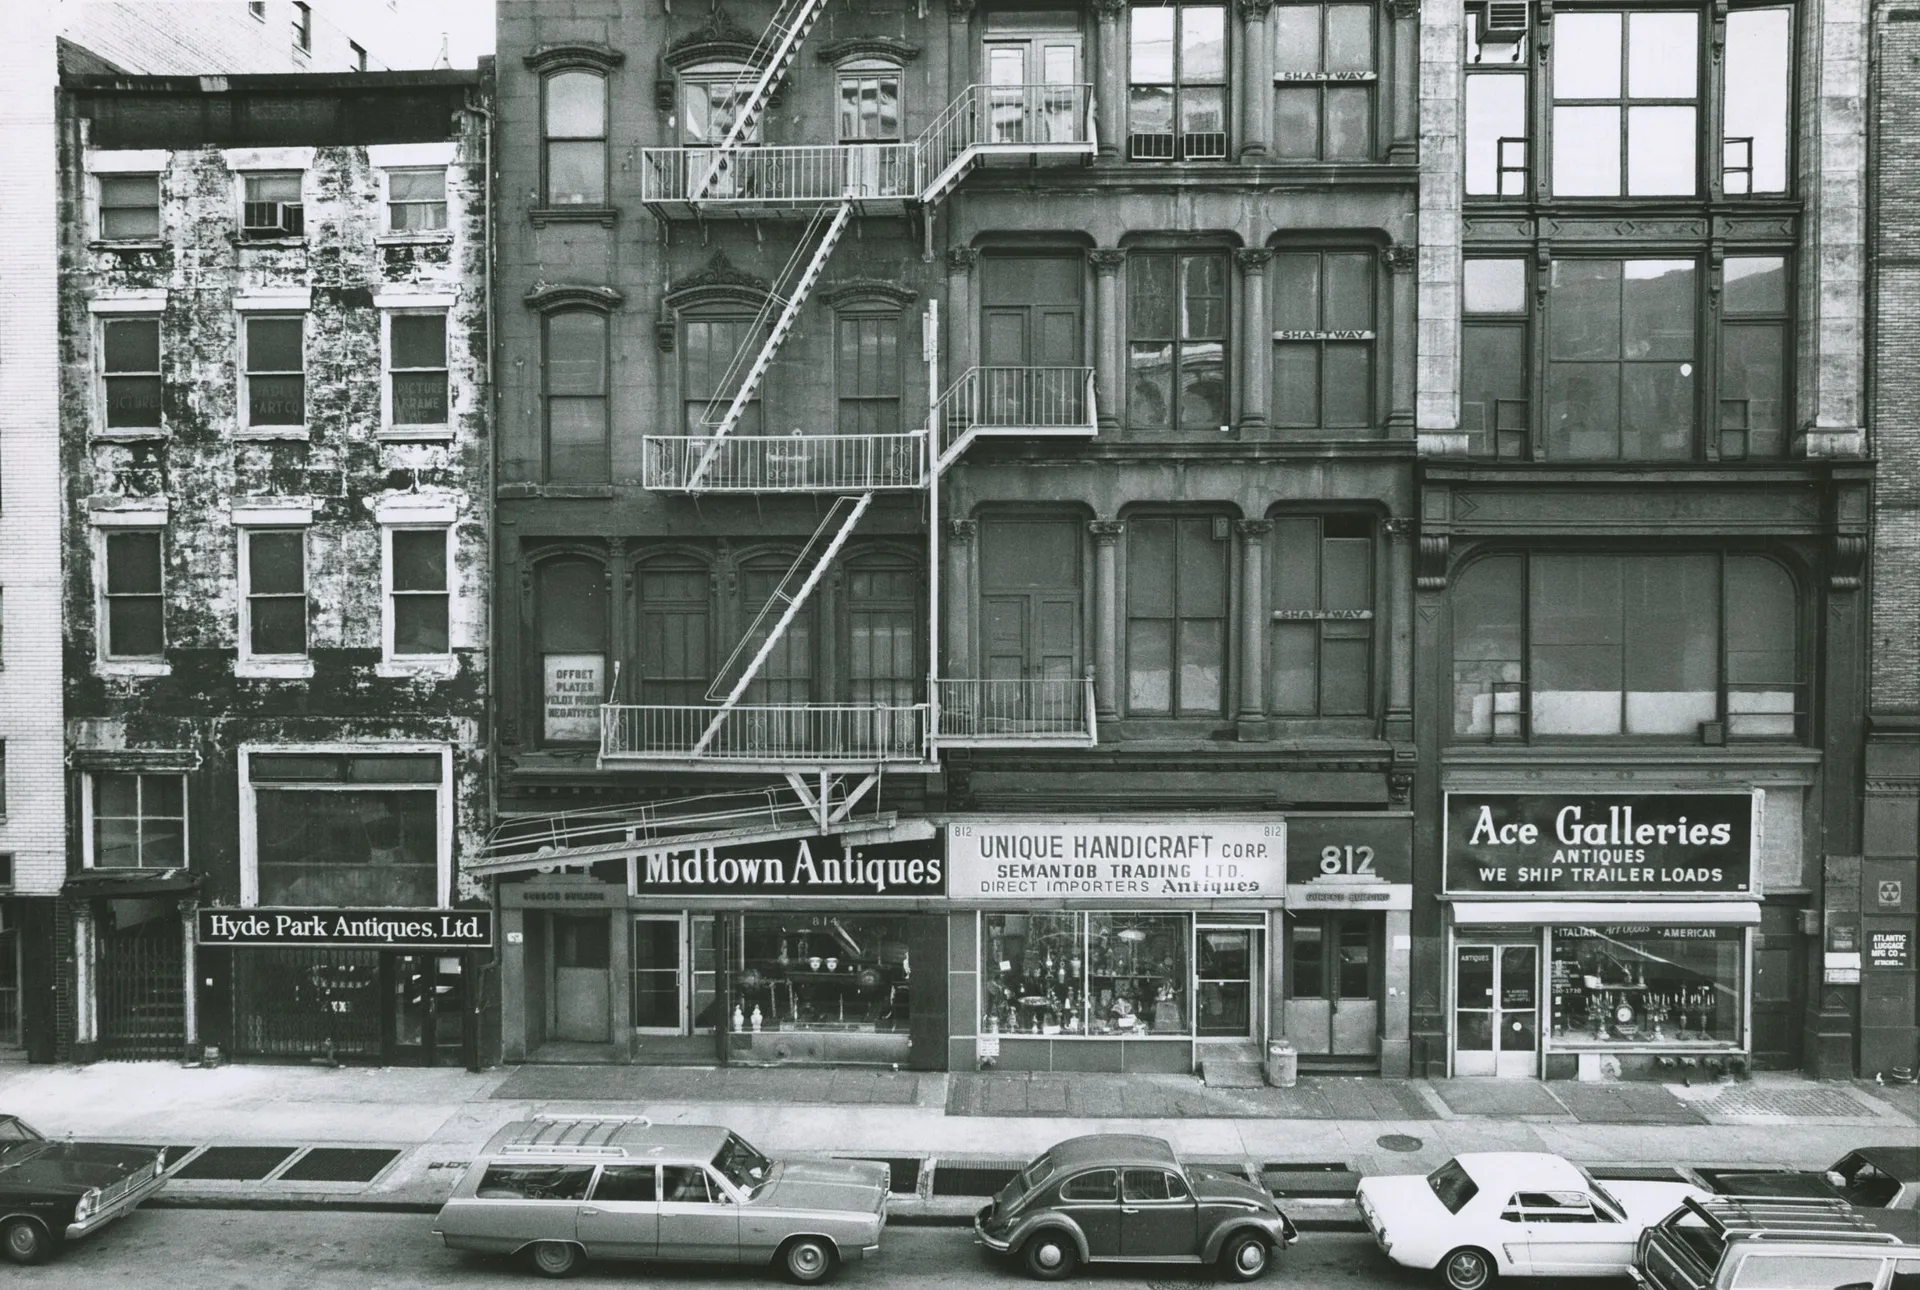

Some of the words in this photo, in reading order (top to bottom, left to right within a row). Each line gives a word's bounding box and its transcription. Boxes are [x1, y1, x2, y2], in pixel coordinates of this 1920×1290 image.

[1284, 72, 1366, 80] SHAFTWAY
[1282, 330, 1366, 339] SHAFTWAY
[556, 669, 594, 679] OFFSET
[556, 682, 594, 692] PLATES
[1469, 805, 1539, 845] Ace
[1556, 805, 1732, 846] Galleries
[956, 827, 971, 837] 812
[1264, 827, 1281, 837] 812
[981, 836, 1063, 860] UNIQUE
[1075, 835, 1213, 859] HANDICRAFT
[1222, 843, 1267, 858] CORP.
[1320, 845, 1375, 875] 812
[1552, 849, 1645, 866] ANTIQUES
[645, 849, 784, 884] Midtown
[792, 840, 942, 892] Antiques
[998, 864, 1097, 879] SEMANTOB
[1111, 864, 1190, 879] TRADING
[1205, 865, 1245, 878] LTD.
[1479, 868, 1507, 882] WE
[1518, 868, 1562, 882] SHIP
[1571, 868, 1655, 882] TRAILER
[1661, 868, 1723, 882] LOADS
[981, 880, 1038, 892] DIRECT
[1046, 880, 1150, 892] IMPORTERS
[1161, 878, 1260, 894] Antiques
[812, 917, 838, 926] 814
[210, 915, 270, 938] Hyde
[275, 915, 328, 936] Park
[332, 915, 438, 942] Antiques,
[441, 916, 484, 938] Ltd.
[1663, 928, 1717, 938] AMERICAN
[1873, 934, 1907, 942] ATLANTIC
[1460, 954, 1490, 962] ANTIQUES
[1871, 949, 1886, 957] MFG
[1888, 949, 1899, 957] CO
